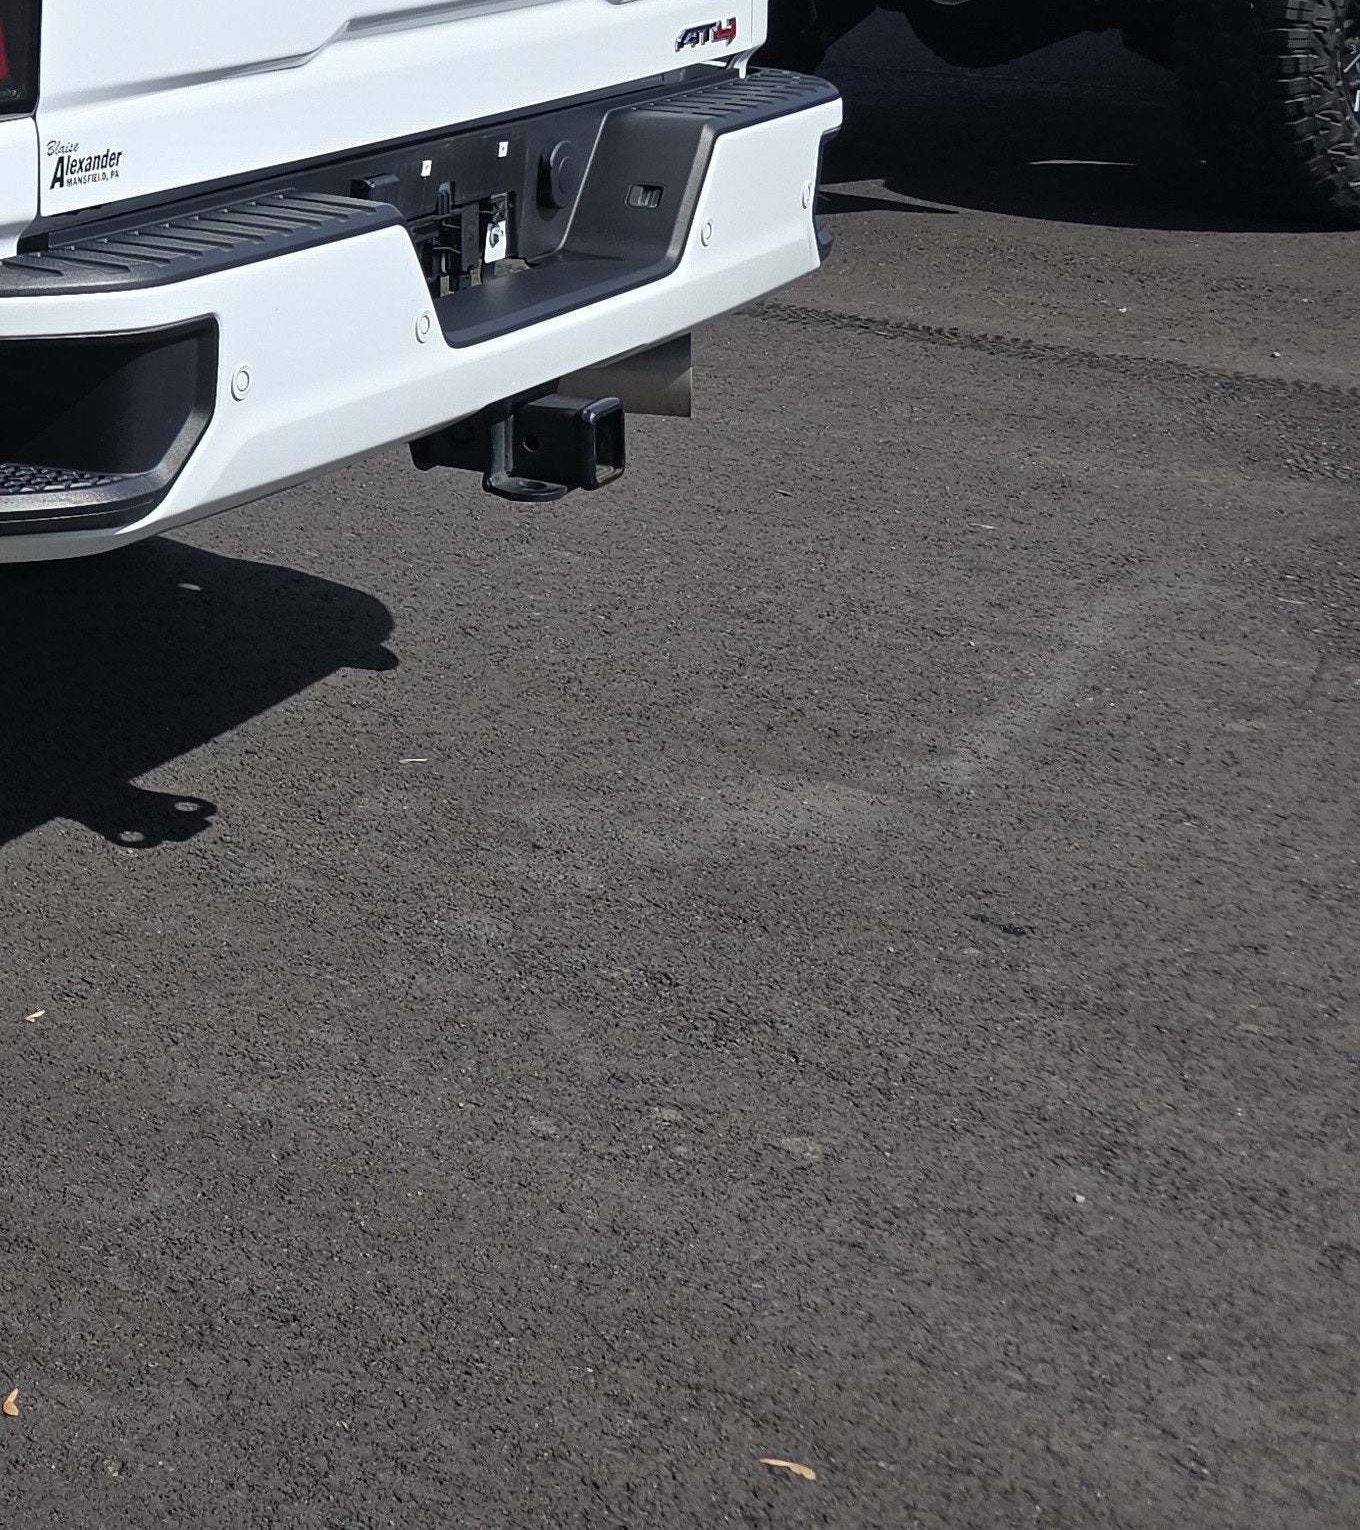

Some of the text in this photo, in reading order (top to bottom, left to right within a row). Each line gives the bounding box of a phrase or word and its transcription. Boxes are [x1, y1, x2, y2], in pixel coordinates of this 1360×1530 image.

[674, 16, 737, 52] AT4
[46, 140, 79, 156] Blaise
[49, 149, 123, 190] Alexander
[66, 170, 119, 187] MANSFIELD, PA
